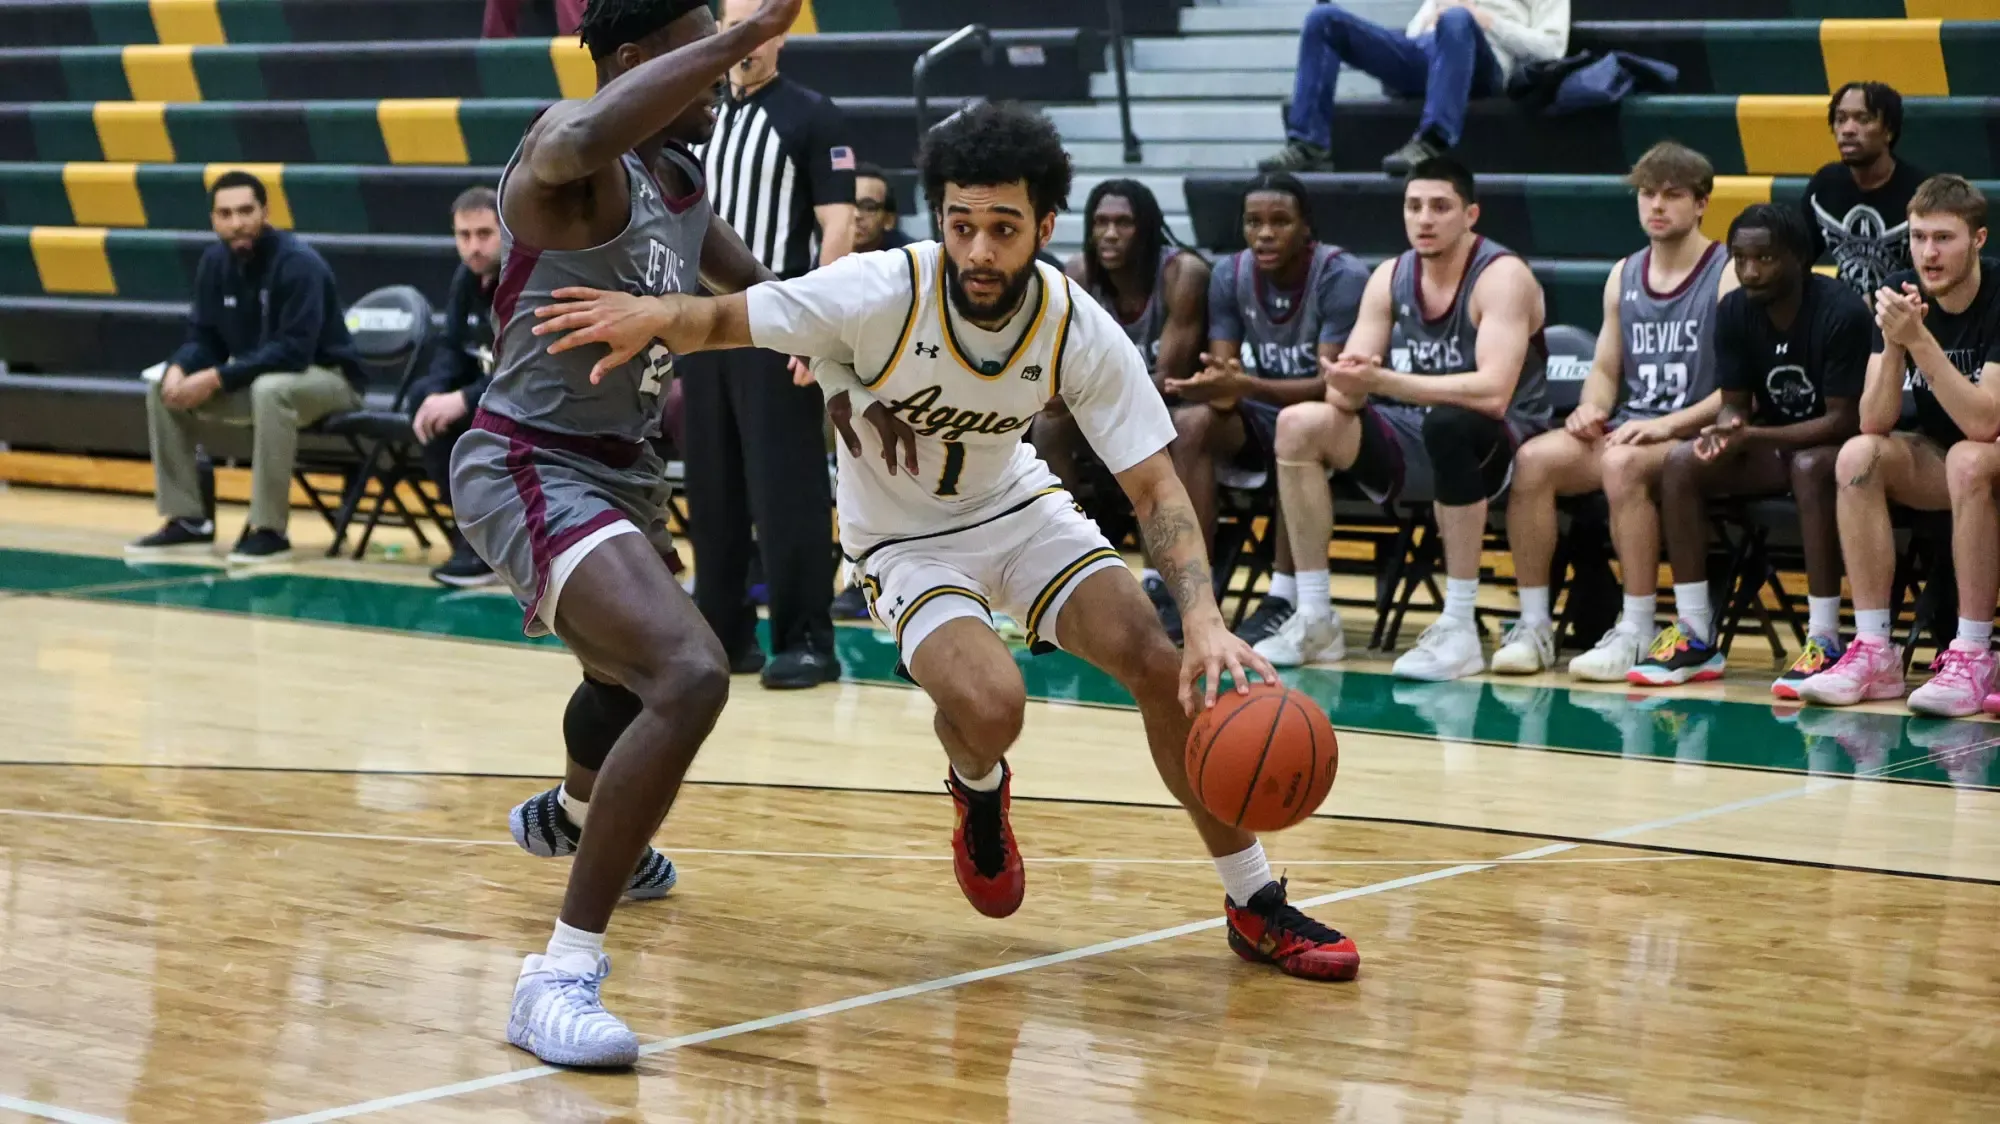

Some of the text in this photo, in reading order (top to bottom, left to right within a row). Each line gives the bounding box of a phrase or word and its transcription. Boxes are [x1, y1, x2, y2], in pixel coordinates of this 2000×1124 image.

[645, 237, 685, 294] DEVIL
[1632, 320, 1698, 354] DEVILS
[890, 385, 1034, 440] Aggie
[933, 440, 967, 496] 1
